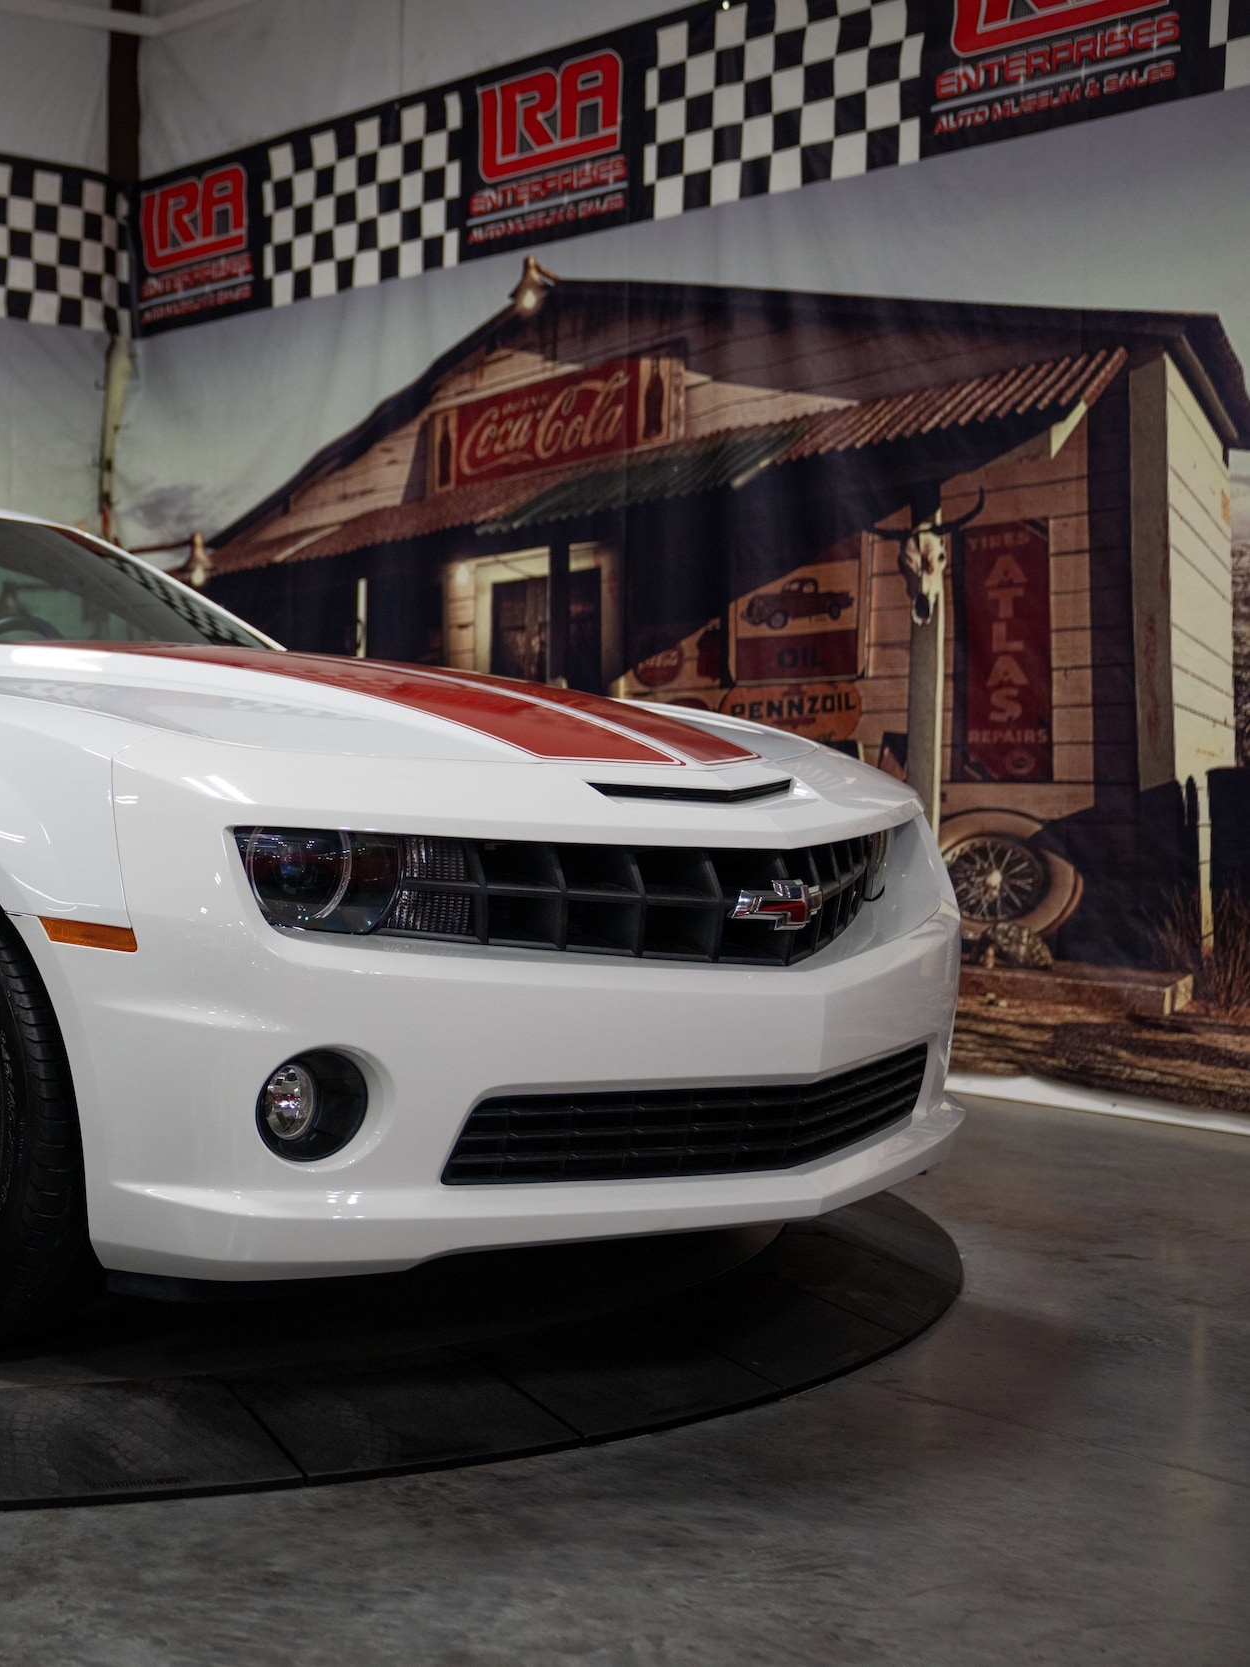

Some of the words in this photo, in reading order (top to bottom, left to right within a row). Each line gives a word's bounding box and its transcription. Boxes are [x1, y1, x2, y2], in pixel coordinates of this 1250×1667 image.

[935, 11, 1180, 99] ENTERPRISES
[477, 48, 623, 184] LRA
[934, 106, 990, 135] AUTO
[991, 82, 1082, 122] MUSEUM
[1085, 77, 1100, 99] &
[1103, 59, 1176, 95] SALES
[140, 163, 248, 274] LRA
[469, 154, 628, 216] ENTERPRISES
[777, 647, 823, 669] OIL
[984, 554, 1029, 723] ATLAS
[731, 692, 857, 718] PENNZOIL
[967, 728, 1048, 744] REPAIRS
